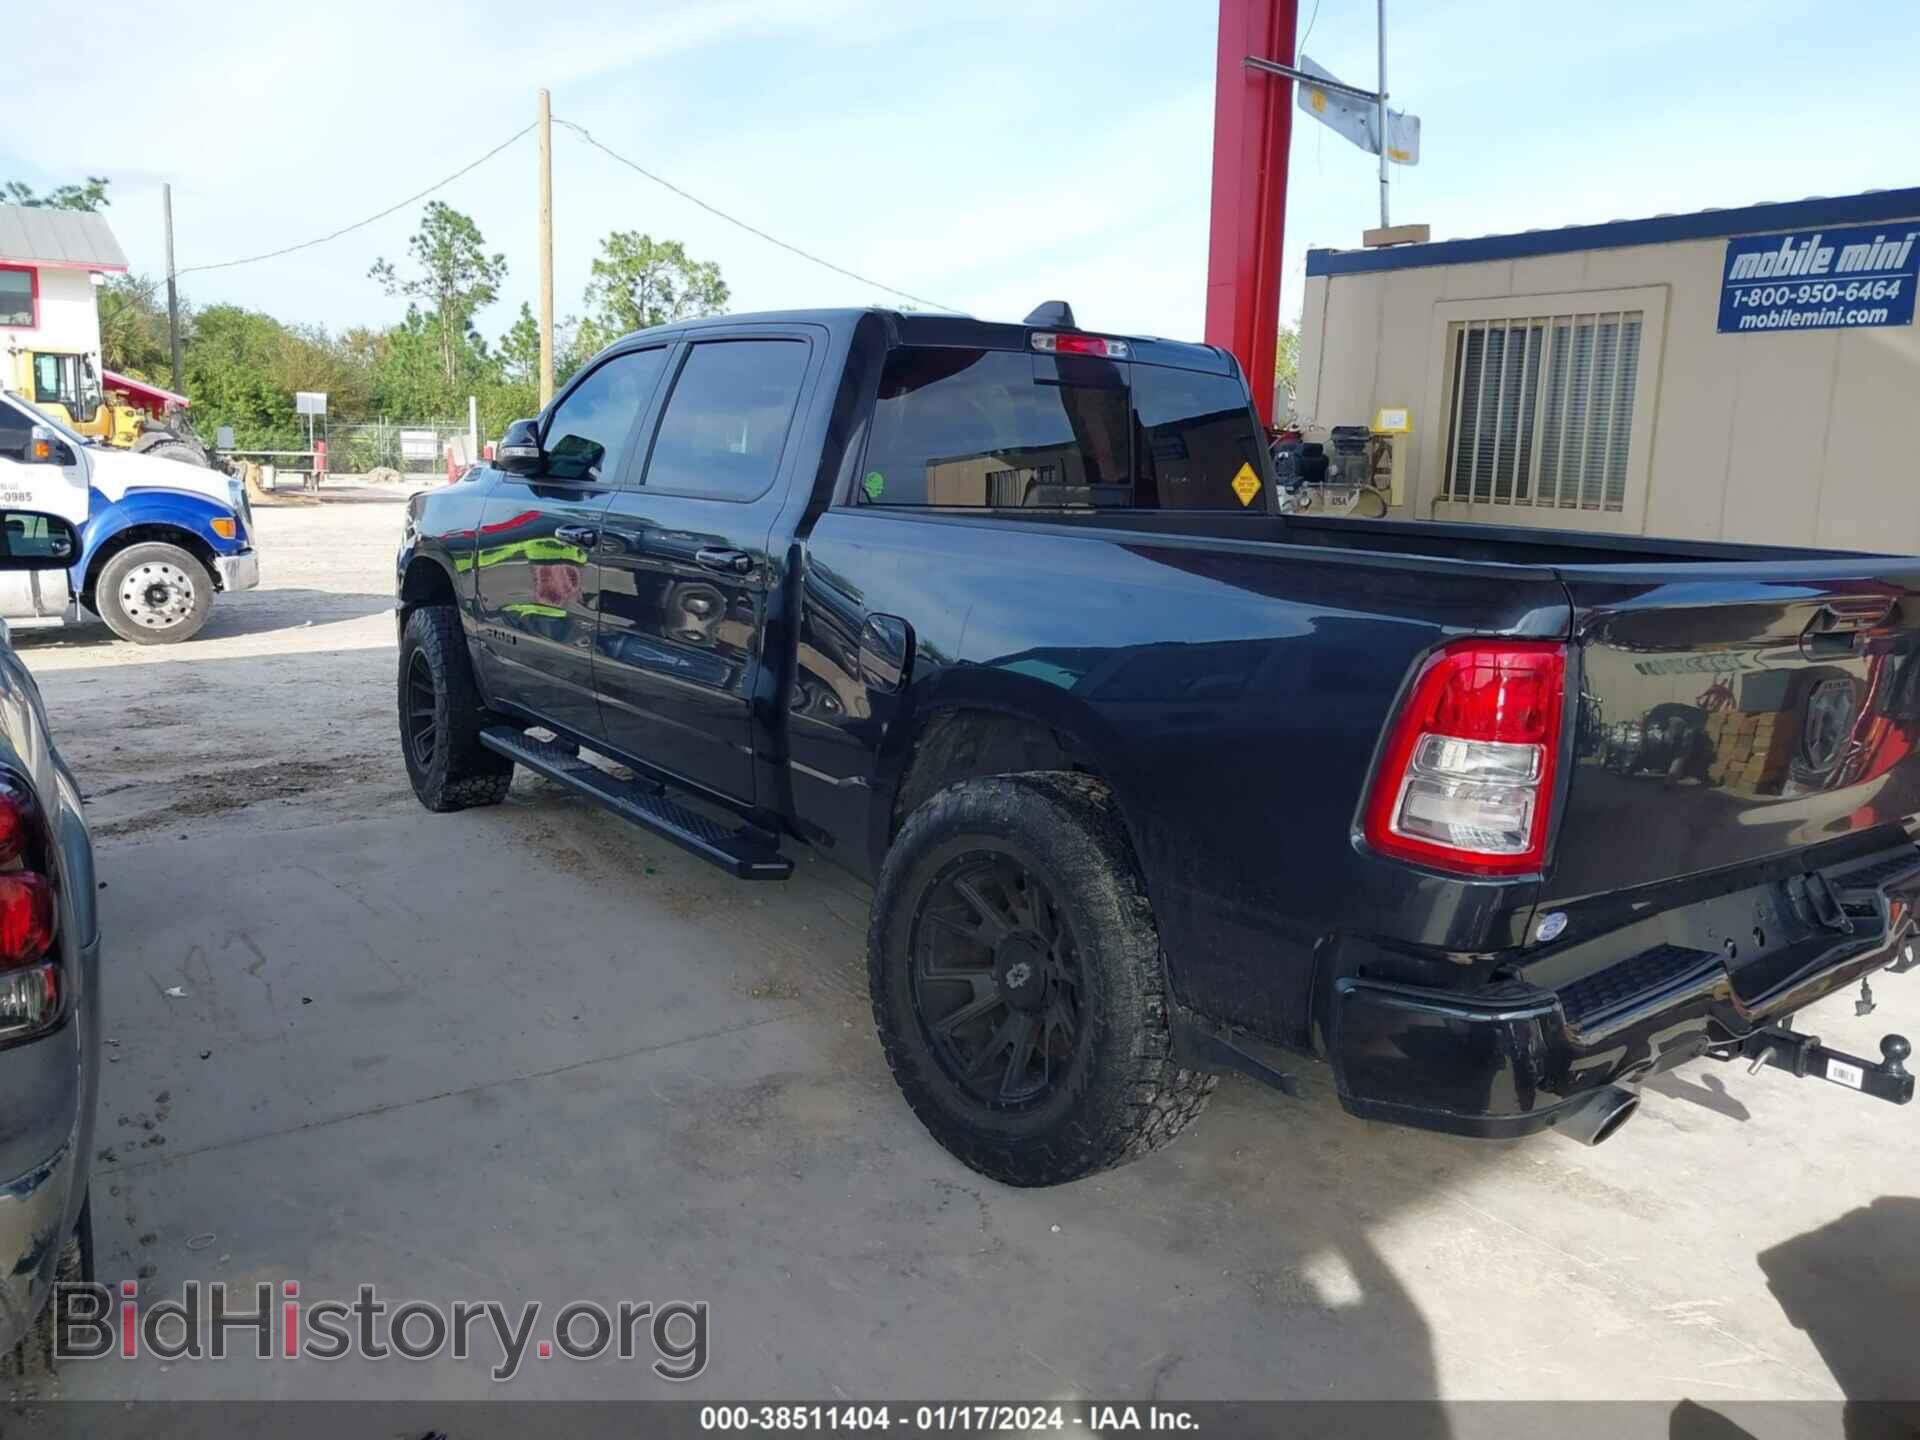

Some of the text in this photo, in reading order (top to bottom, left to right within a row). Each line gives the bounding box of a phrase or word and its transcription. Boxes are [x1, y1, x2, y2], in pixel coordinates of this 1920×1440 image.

[1728, 233, 1916, 280] mobile mini
[1733, 280, 1900, 308] 1-800-950-6464
[1739, 307, 1888, 329] mobilemini.com
